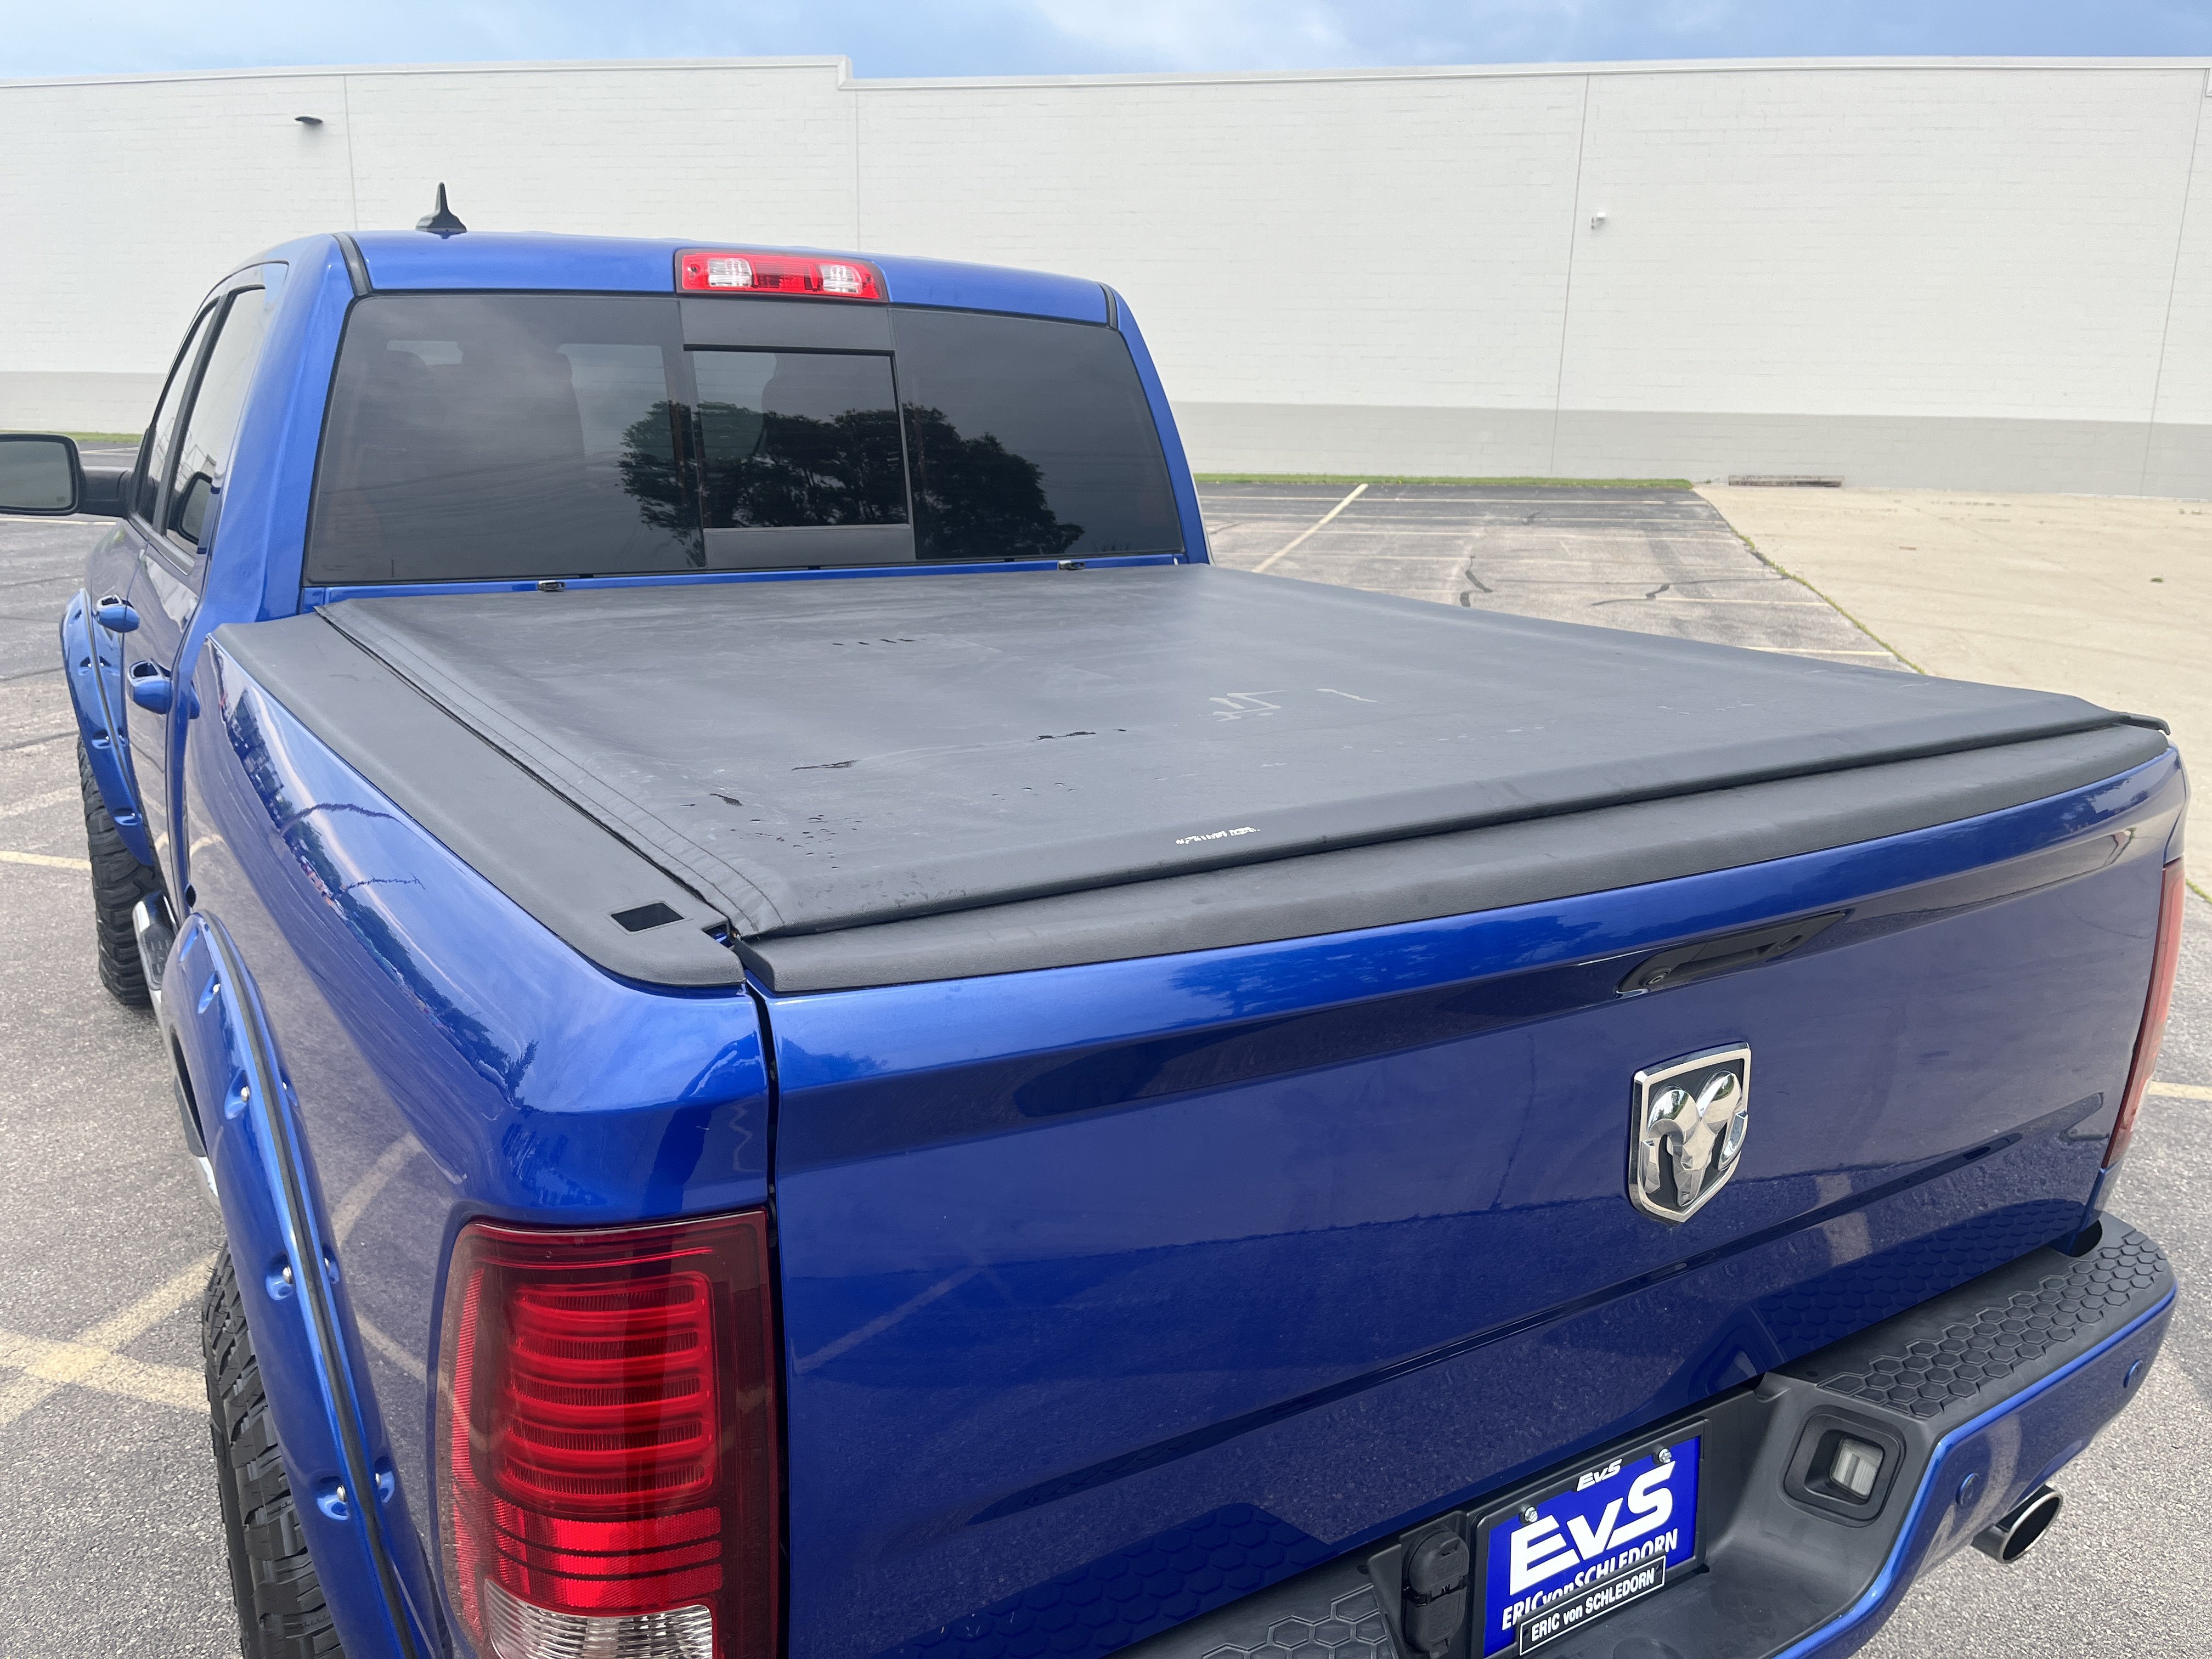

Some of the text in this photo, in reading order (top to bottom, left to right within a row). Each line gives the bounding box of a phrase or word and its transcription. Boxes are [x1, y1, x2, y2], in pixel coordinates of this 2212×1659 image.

[1531, 1567, 1655, 1642] ERIC von SCHLEDORN
